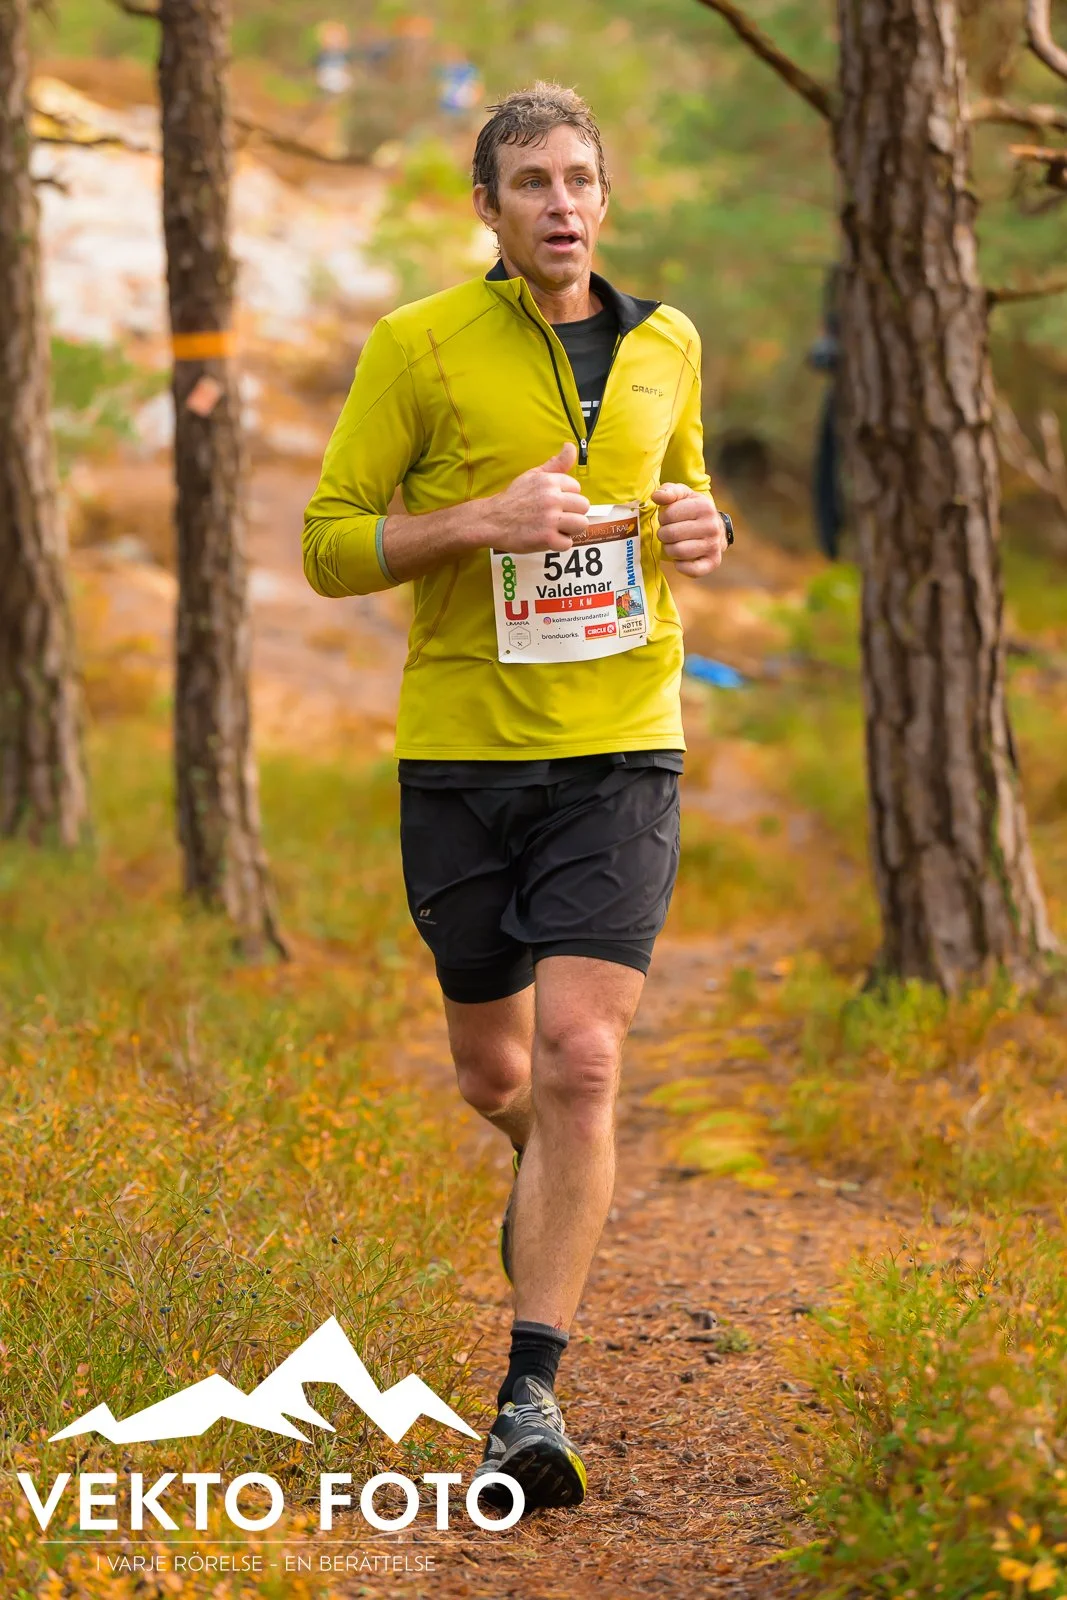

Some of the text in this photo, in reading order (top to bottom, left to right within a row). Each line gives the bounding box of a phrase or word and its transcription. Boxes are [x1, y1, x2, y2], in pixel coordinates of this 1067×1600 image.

[631, 384, 658, 395] CRAFT
[543, 547, 603, 581] 548
[625, 539, 636, 586] Aktivitus
[501, 556, 516, 600] coop
[535, 580, 612, 599] Valdemar
[587, 626, 606, 635] CIRCLE
